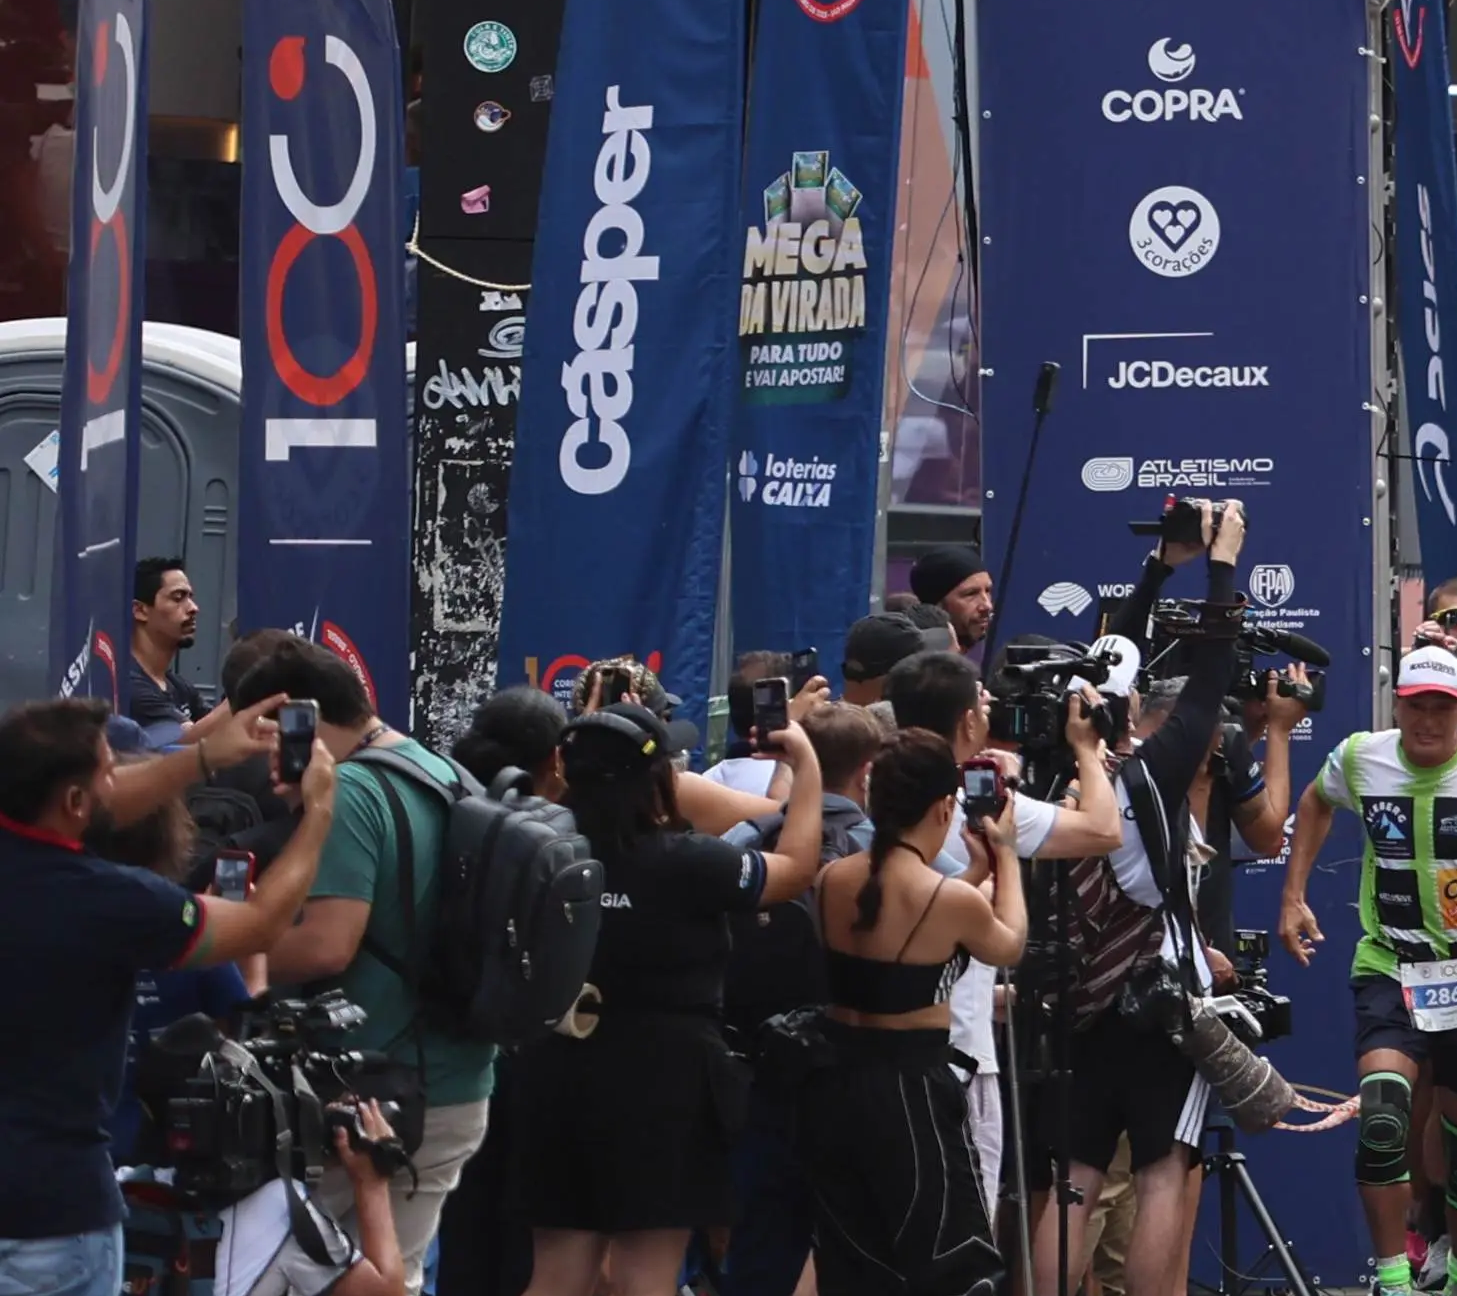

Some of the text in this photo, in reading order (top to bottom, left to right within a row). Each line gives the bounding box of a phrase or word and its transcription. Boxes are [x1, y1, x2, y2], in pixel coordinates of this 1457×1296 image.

[1101, 88, 1242, 123] COPRA
[743, 217, 868, 279] MEGA
[1135, 236, 1214, 274] 3 corações
[738, 275, 865, 337] DA VIRADA
[750, 341, 843, 366] PARA TUDO
[751, 365, 845, 387] VAI APOSTAR!
[1108, 361, 1270, 389] JCDecaux
[765, 453, 837, 480] loterias
[1138, 458, 1273, 473] ATLETISMO
[761, 480, 831, 507] CAIXA
[1138, 473, 1226, 488] BRASIL
